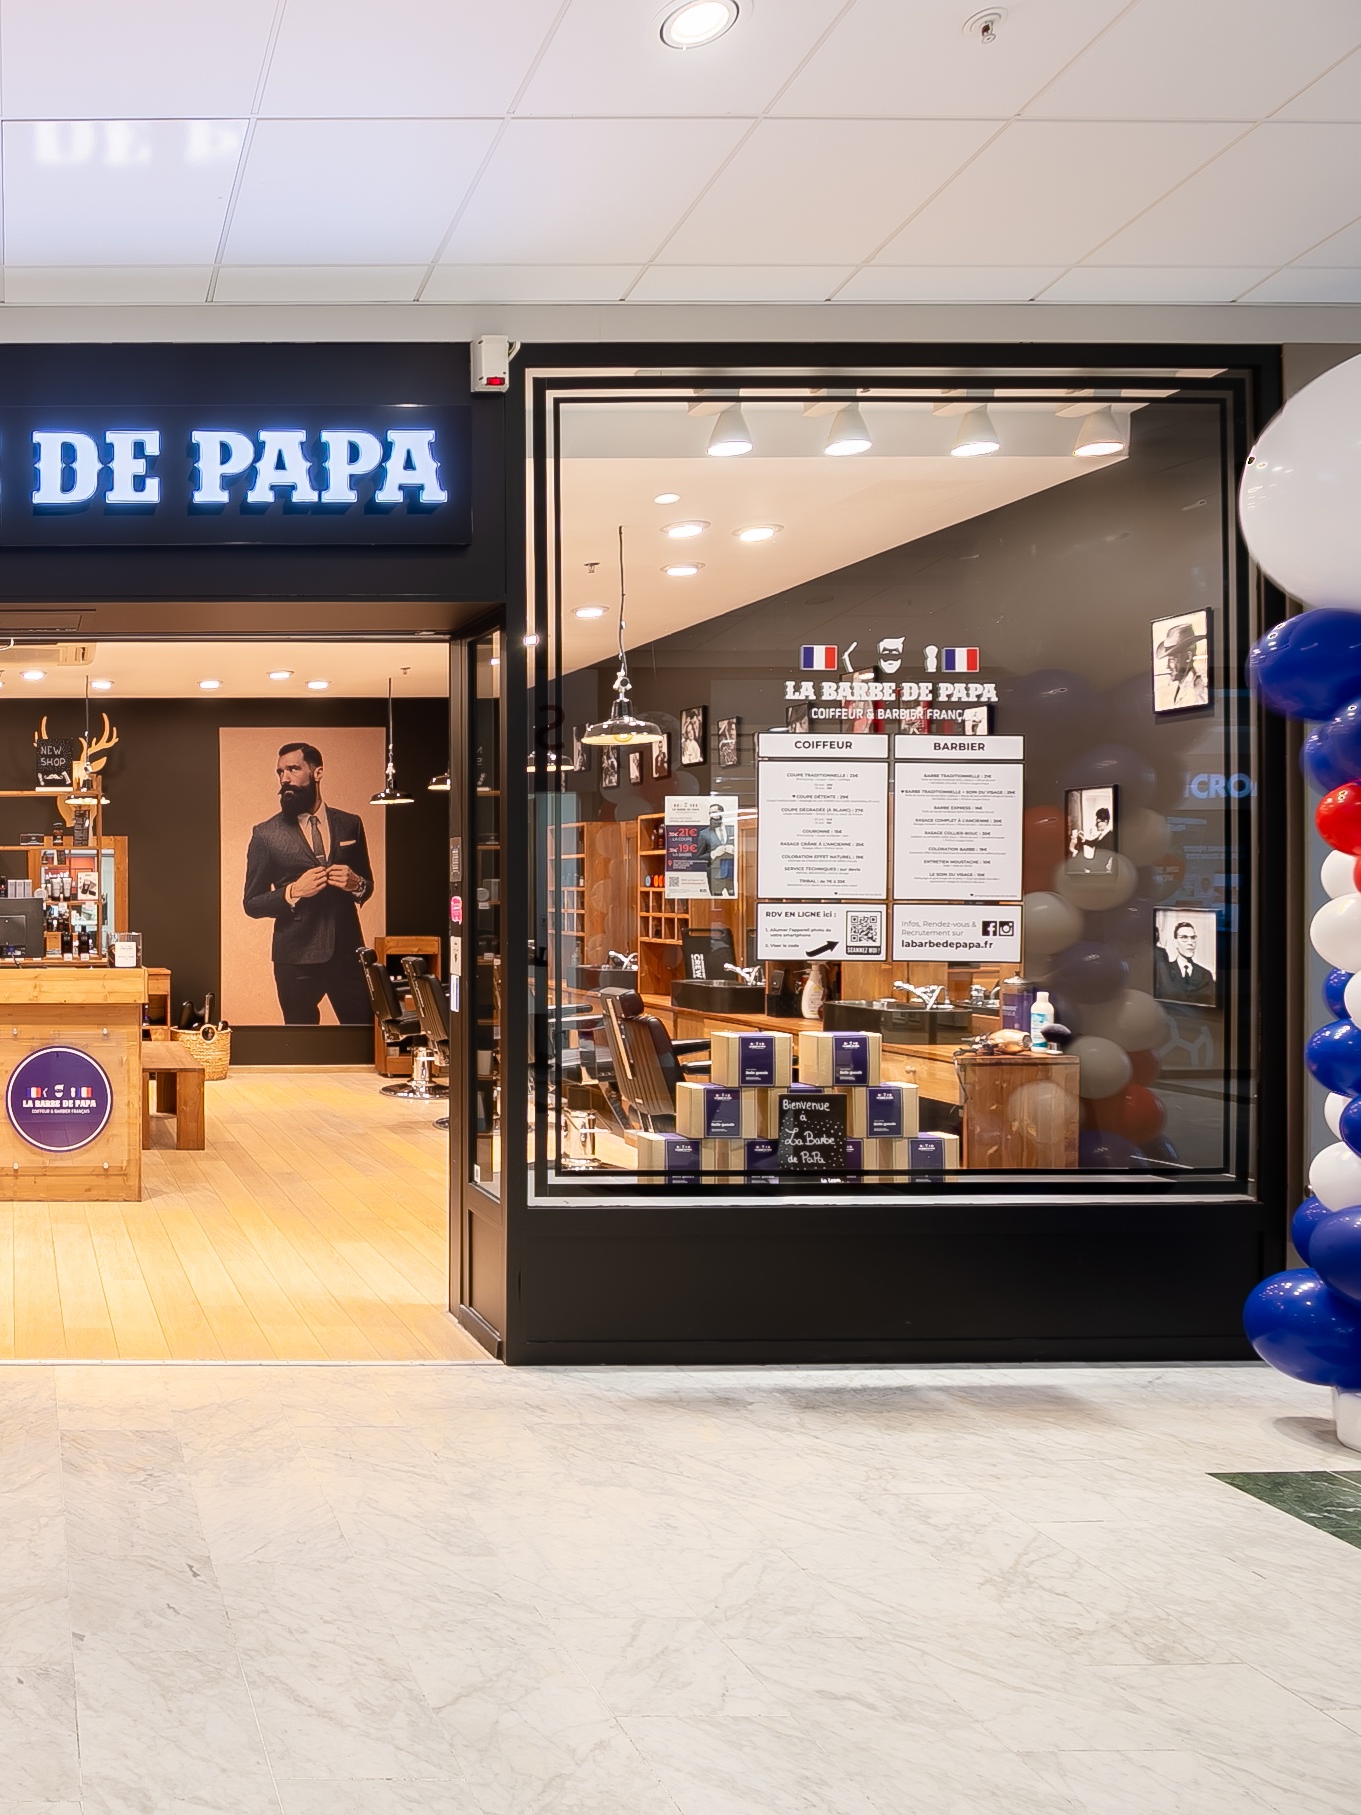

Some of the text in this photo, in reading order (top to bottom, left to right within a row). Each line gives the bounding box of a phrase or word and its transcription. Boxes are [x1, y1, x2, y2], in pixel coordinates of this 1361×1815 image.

[30, 428, 162, 506] DE
[190, 427, 449, 505] PAPA
[784, 681, 998, 701] LA BARBE DE PAPA
[811, 708, 862, 720] COIFFEUR
[867, 708, 874, 720] &
[878, 708, 923, 720] BARBIER
[794, 740, 853, 749] COIFFEUR
[933, 742, 986, 751] BARBIER
[40, 746, 62, 755] NEW
[40, 757, 66, 767] SHOP
[901, 920, 921, 928] Infos,
[901, 939, 993, 950] labarbedepapa.fr
[693, 953, 703, 978] CREW
[22, 1100, 97, 1108] LA BARBE DE PAPA
[782, 1099, 831, 1112] Bienvenue
[799, 1111, 808, 1122] à
[784, 1127, 836, 1146] La Barbe
[787, 1154, 799, 1164] de
